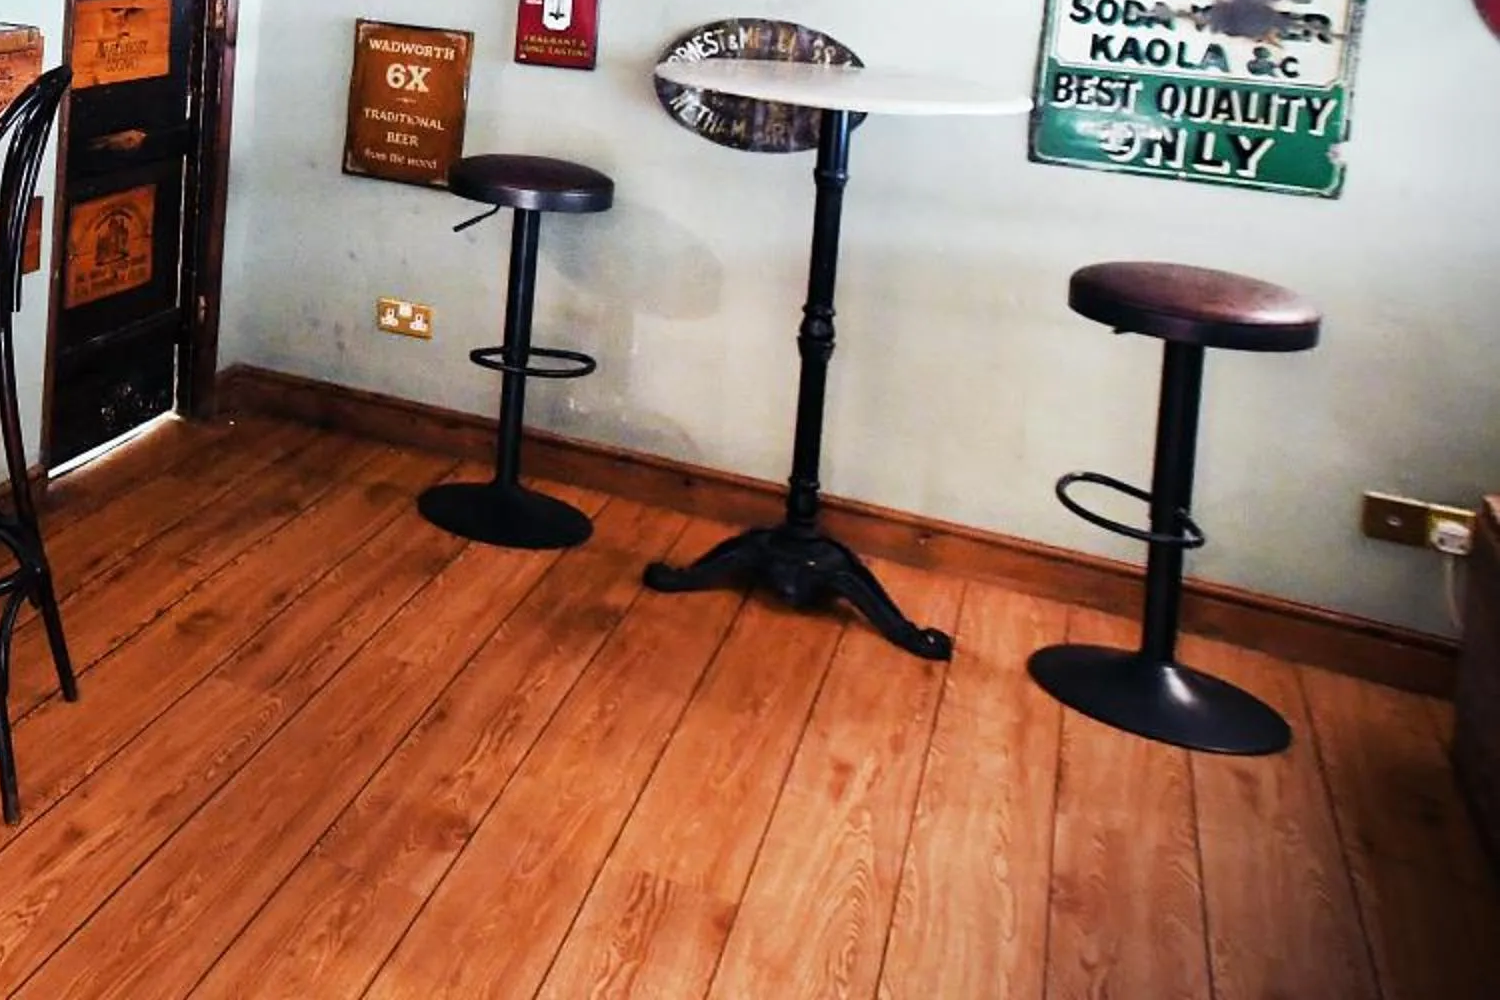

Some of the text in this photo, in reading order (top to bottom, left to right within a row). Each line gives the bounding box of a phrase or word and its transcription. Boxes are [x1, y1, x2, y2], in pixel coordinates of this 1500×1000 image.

[369, 38, 455, 61] WADWORTH
[1089, 32, 1230, 72] KAOLA
[386, 63, 432, 93] 6X
[1051, 72, 1338, 137] BEST QUALITY
[363, 107, 446, 131] TRADITIONAL
[386, 131, 420, 147] BEER
